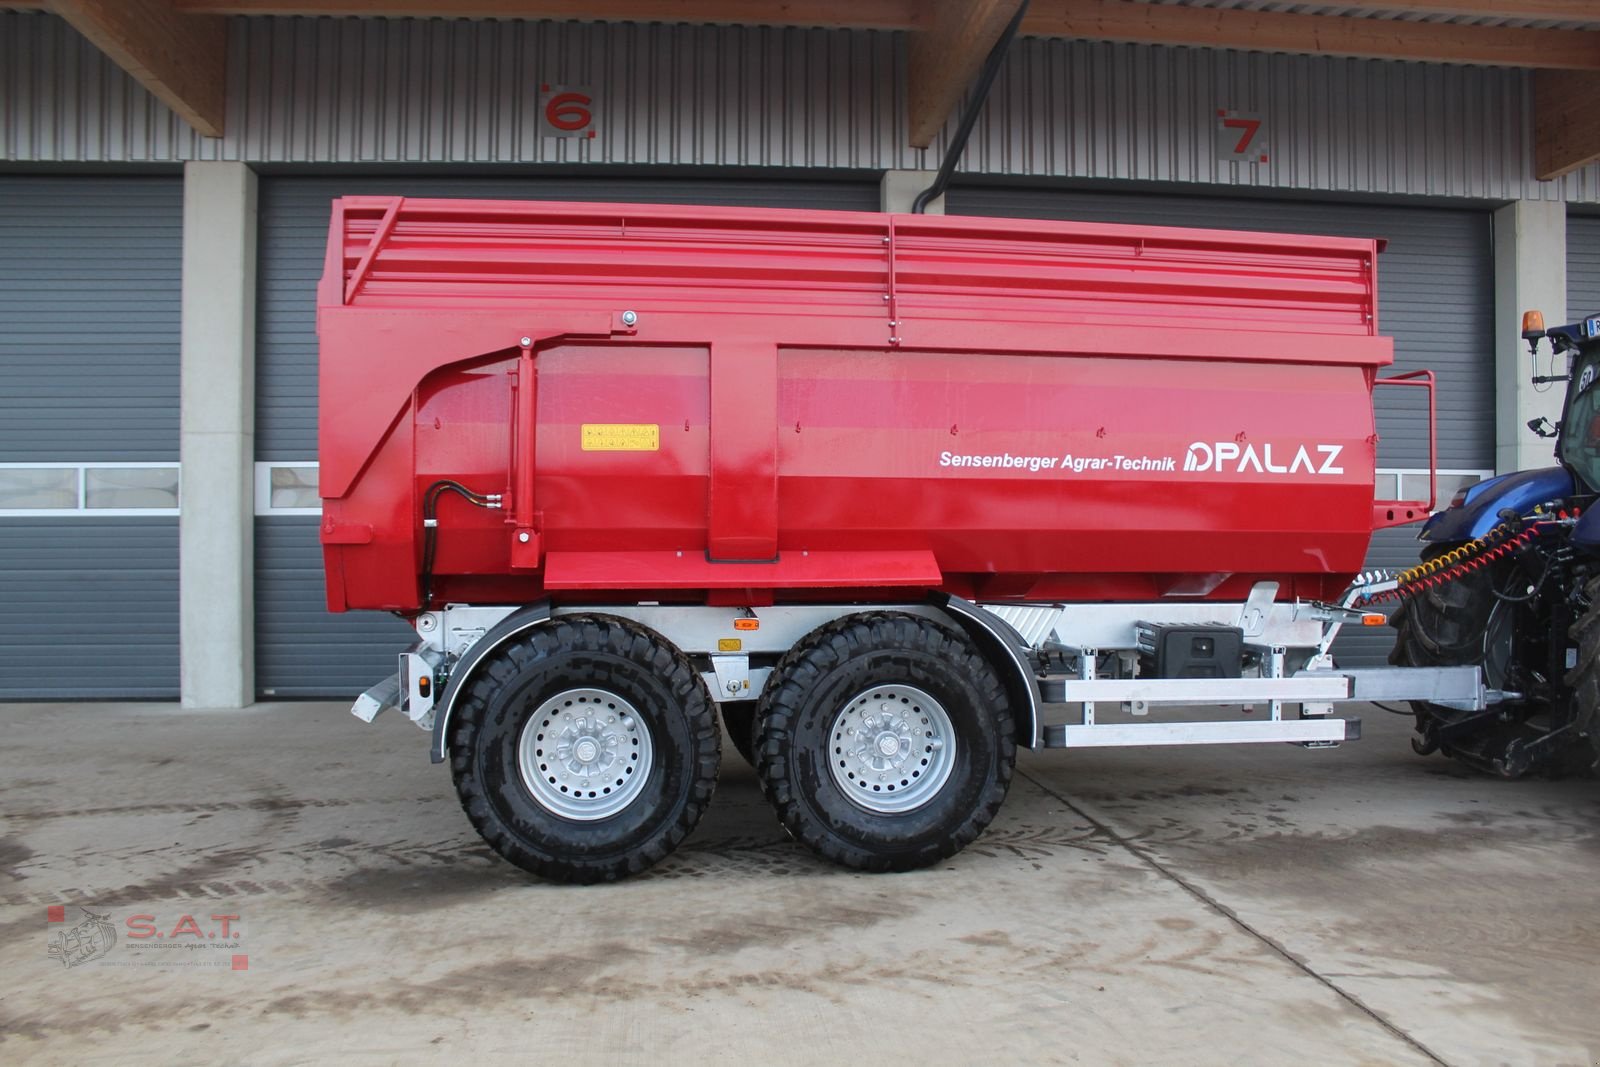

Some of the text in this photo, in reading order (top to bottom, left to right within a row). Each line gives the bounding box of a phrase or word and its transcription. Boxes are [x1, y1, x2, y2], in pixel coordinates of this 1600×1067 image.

[545, 92, 592, 131] 6
[1223, 118, 1262, 154] 7
[939, 451, 1059, 473] Sensenberger
[1060, 453, 1176, 474] Agrar-Technik
